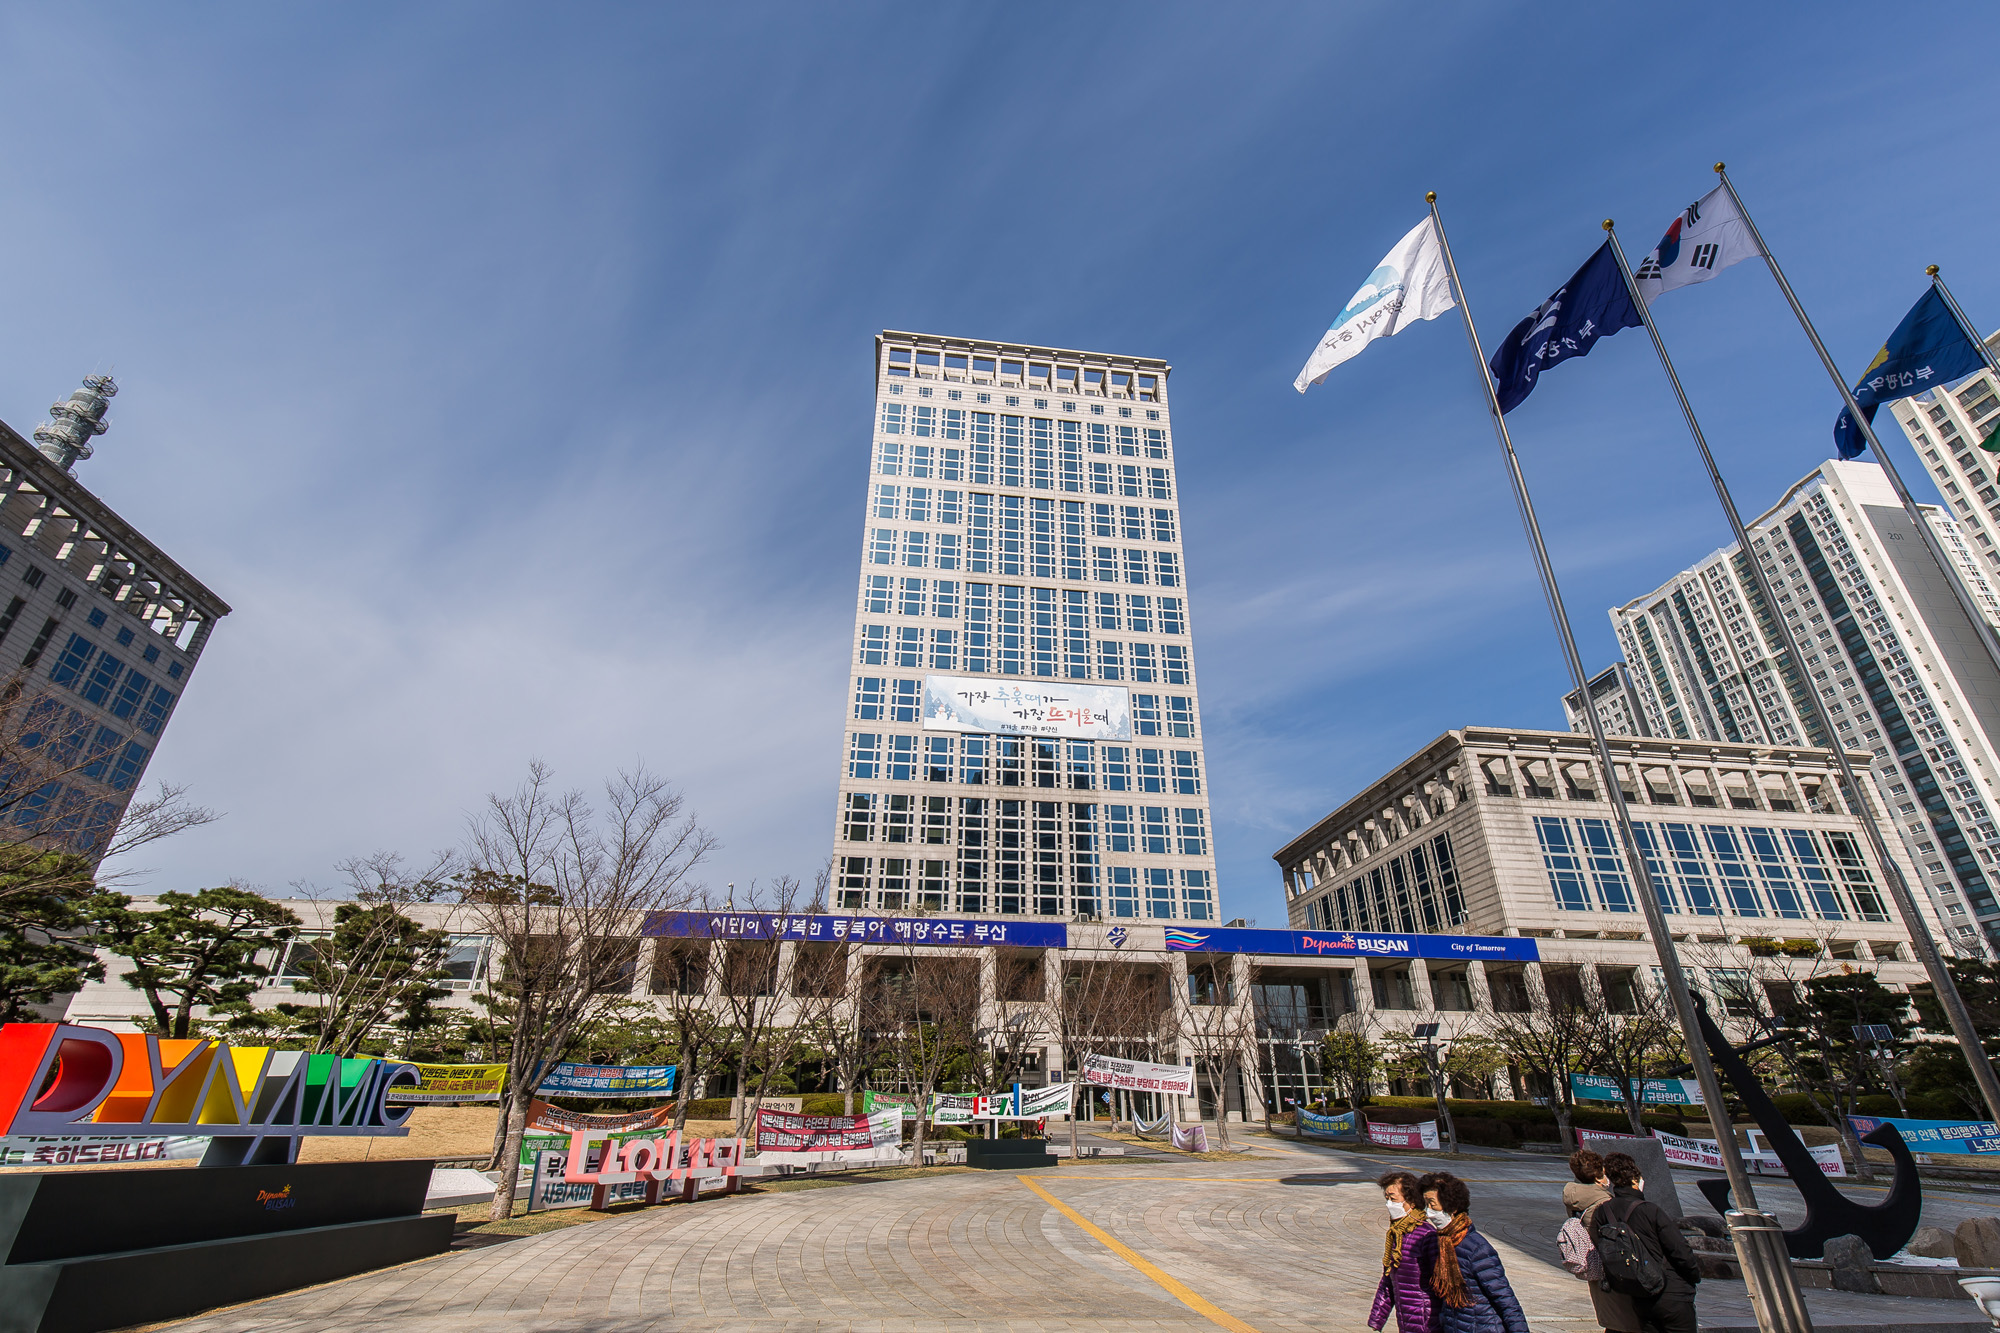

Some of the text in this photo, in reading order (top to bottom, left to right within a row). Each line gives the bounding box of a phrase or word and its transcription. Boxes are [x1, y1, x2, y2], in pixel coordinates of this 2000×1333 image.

[1888, 532, 1904, 541] 201
[957, 691, 991, 706] 가장
[1013, 708, 1045, 721] 가장
[711, 917, 1007, 941] 시민이 행복한 동북아 해양수도 부산
[1302, 936, 1409, 955] Dynamic BUSAN
[1451, 943, 1464, 952] City
[1466, 943, 1473, 952] of
[449, 1069, 472, 1079] 어르신
[1110, 1061, 1135, 1074] 직장갑질!
[1136, 1077, 1160, 1090] 부당해고
[8, 1023, 422, 1165] DYNAMIC
[1647, 1092, 1686, 1103] 규탄한다!
[536, 1115, 563, 1130] 어르신
[804, 1117, 830, 1130] 수단으로
[830, 1117, 856, 1130] 이용하는
[758, 1132, 776, 1146] 효림원
[802, 1132, 828, 1147] 부산시가
[828, 1132, 842, 1146] 직접
[842, 1131, 870, 1146] 운영하라!
[1940, 1125, 1982, 1140] 쟁의행위
[33, 1141, 168, 1165] 축하드립니다.
[256, 1190, 296, 1211] Dynamic BUSAN
